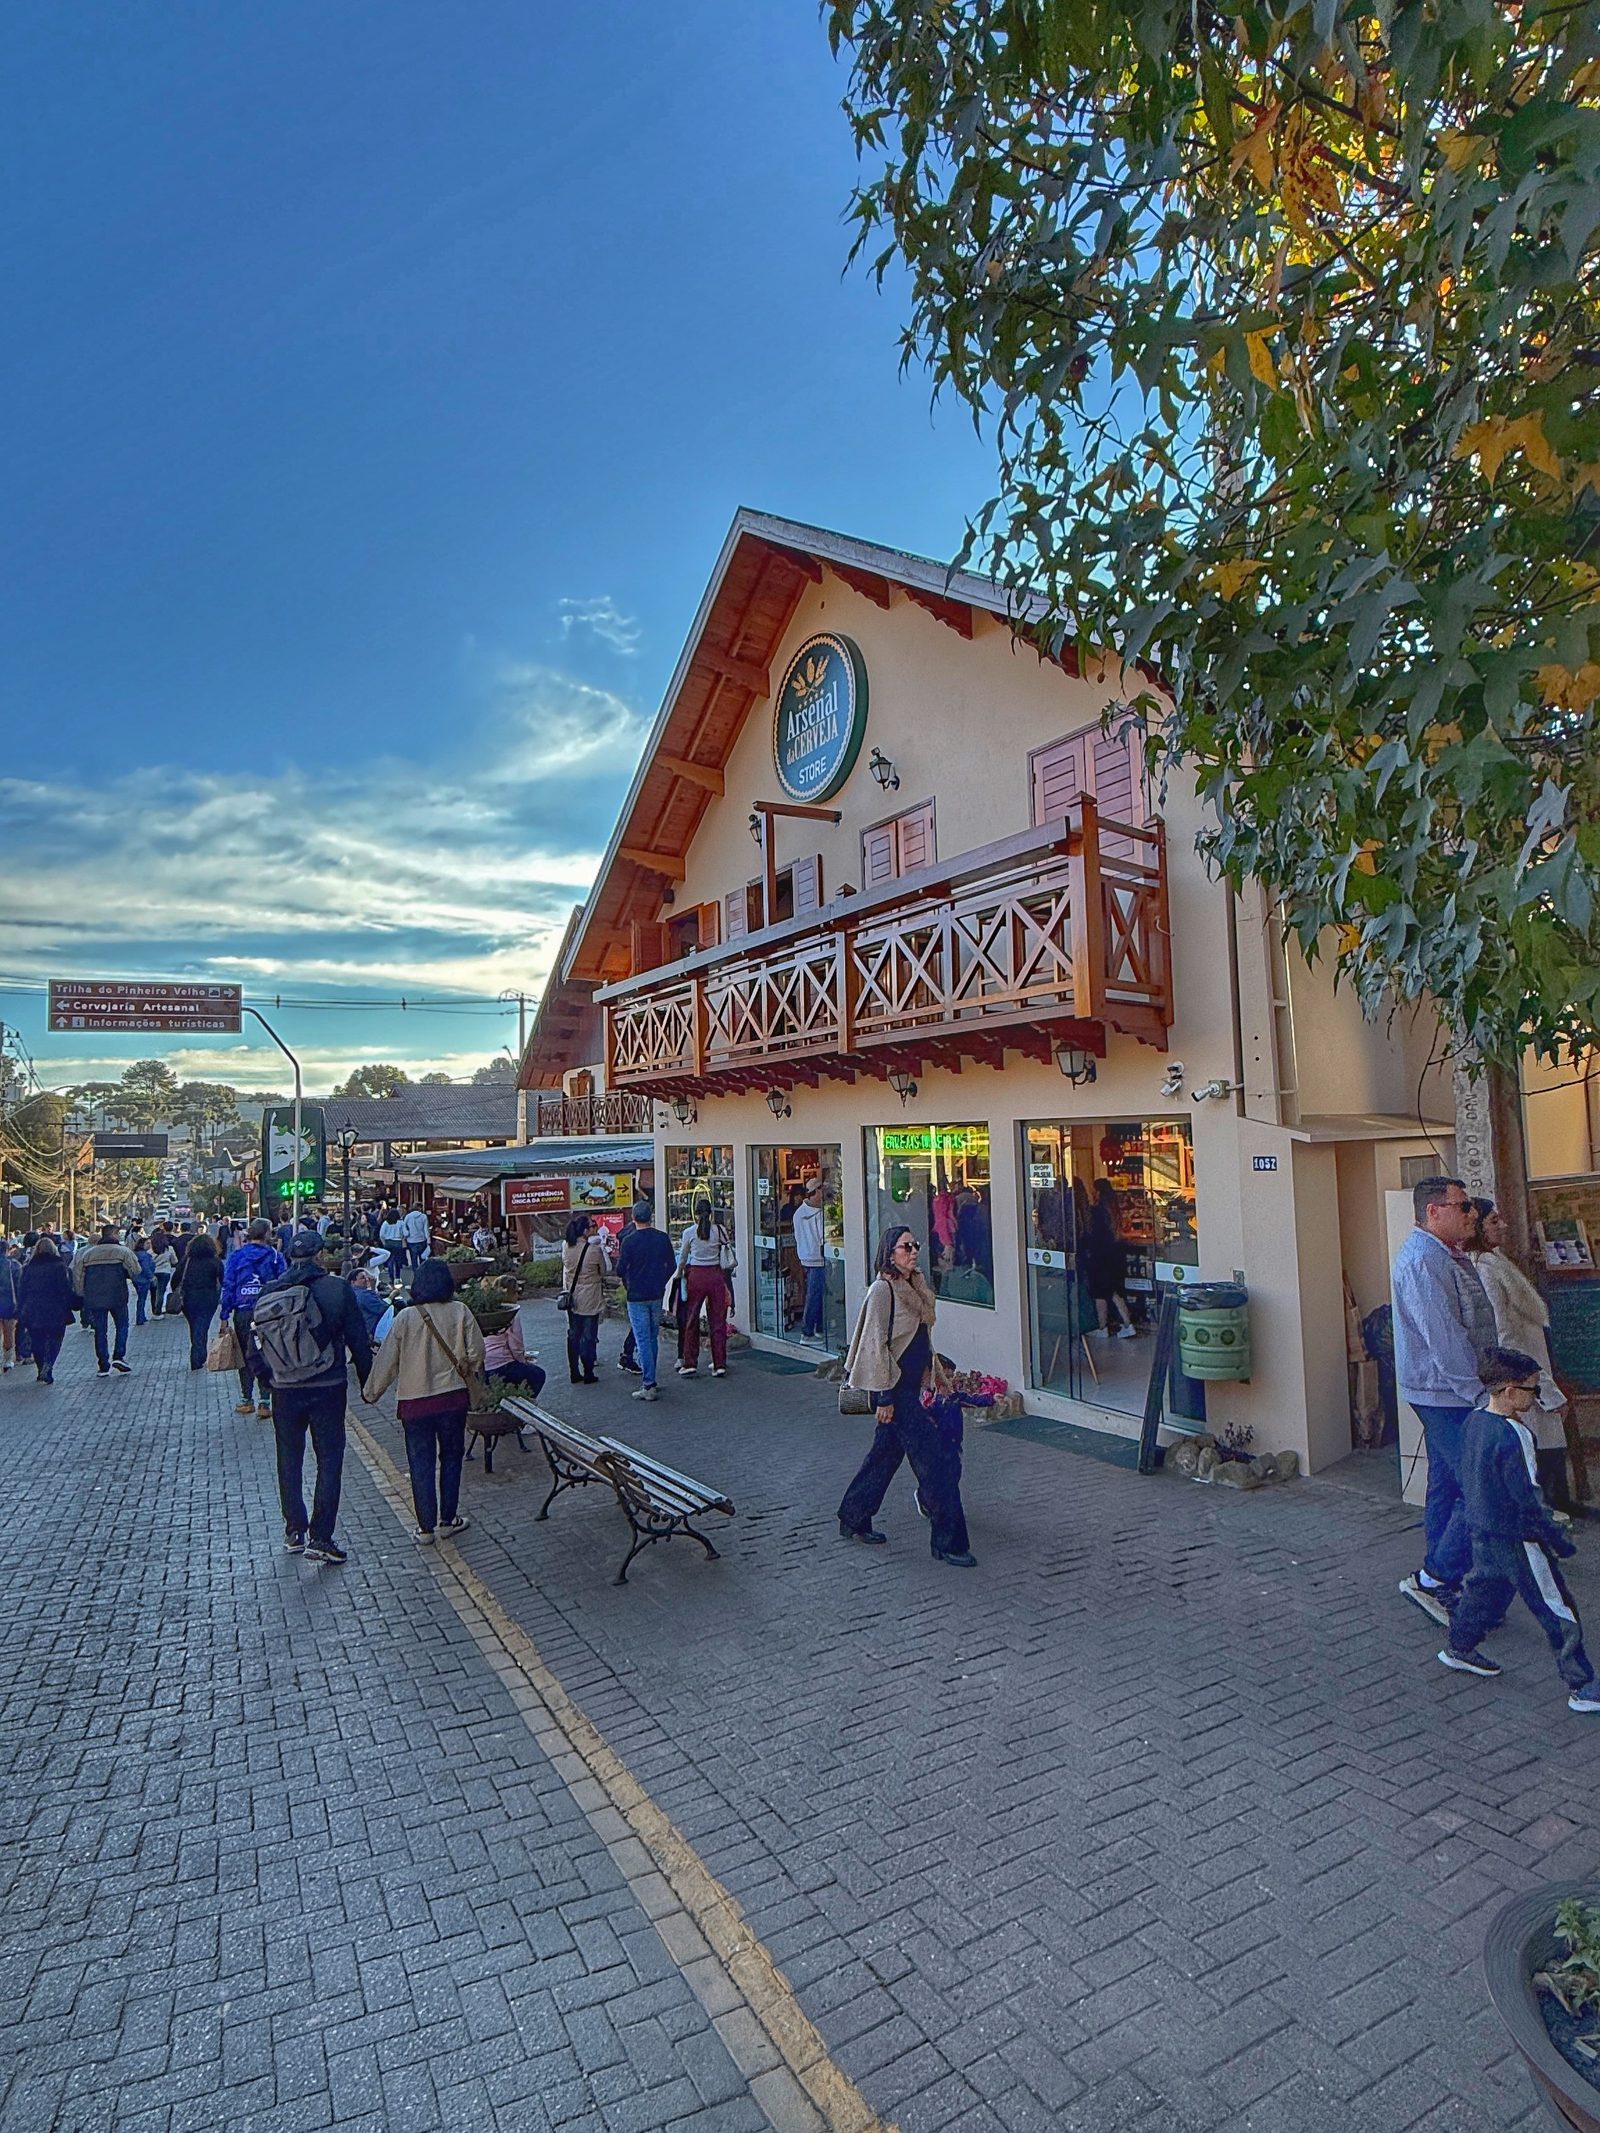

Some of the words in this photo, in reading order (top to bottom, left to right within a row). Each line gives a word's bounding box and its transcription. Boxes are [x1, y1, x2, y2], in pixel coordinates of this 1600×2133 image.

[787, 681, 838, 742] Arsenal
[794, 716, 838, 760] CERVEJA
[799, 756, 827, 784] STORE
[56, 984, 92, 994] Trilha
[98, 985, 113, 994] do
[117, 985, 167, 995] Pinheiro
[174, 987, 206, 996] Velho
[142, 1003, 200, 1012] Artesanal
[89, 1018, 162, 1028] Informações
[168, 1019, 225, 1028] turísticas
